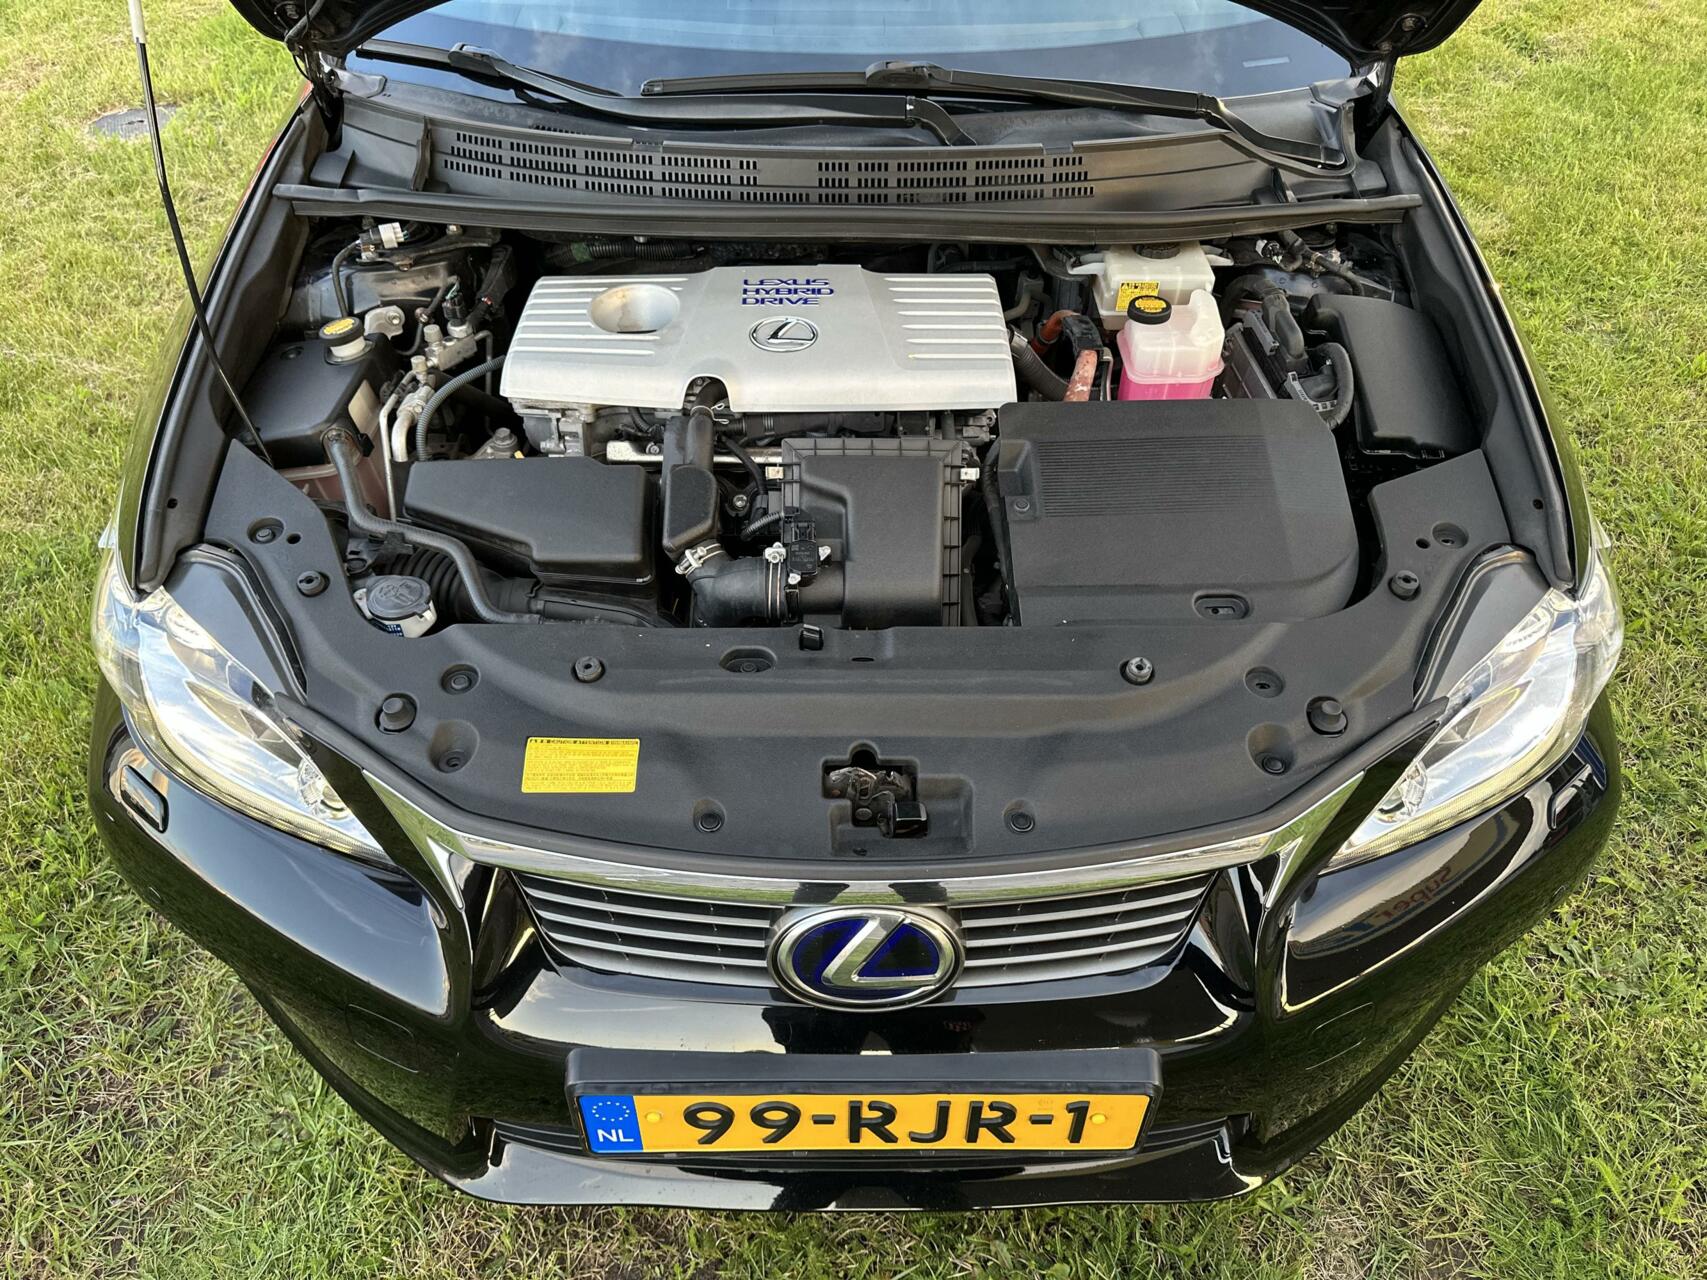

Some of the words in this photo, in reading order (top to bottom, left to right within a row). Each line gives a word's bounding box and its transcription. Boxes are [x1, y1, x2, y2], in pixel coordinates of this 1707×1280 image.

[743, 278, 830, 287] LEXUS
[742, 287, 834, 296] HYBRID
[741, 297, 820, 306] DRIVE
[683, 1100, 1090, 1144] 99-RJR-1
[597, 1128, 634, 1143] NL
